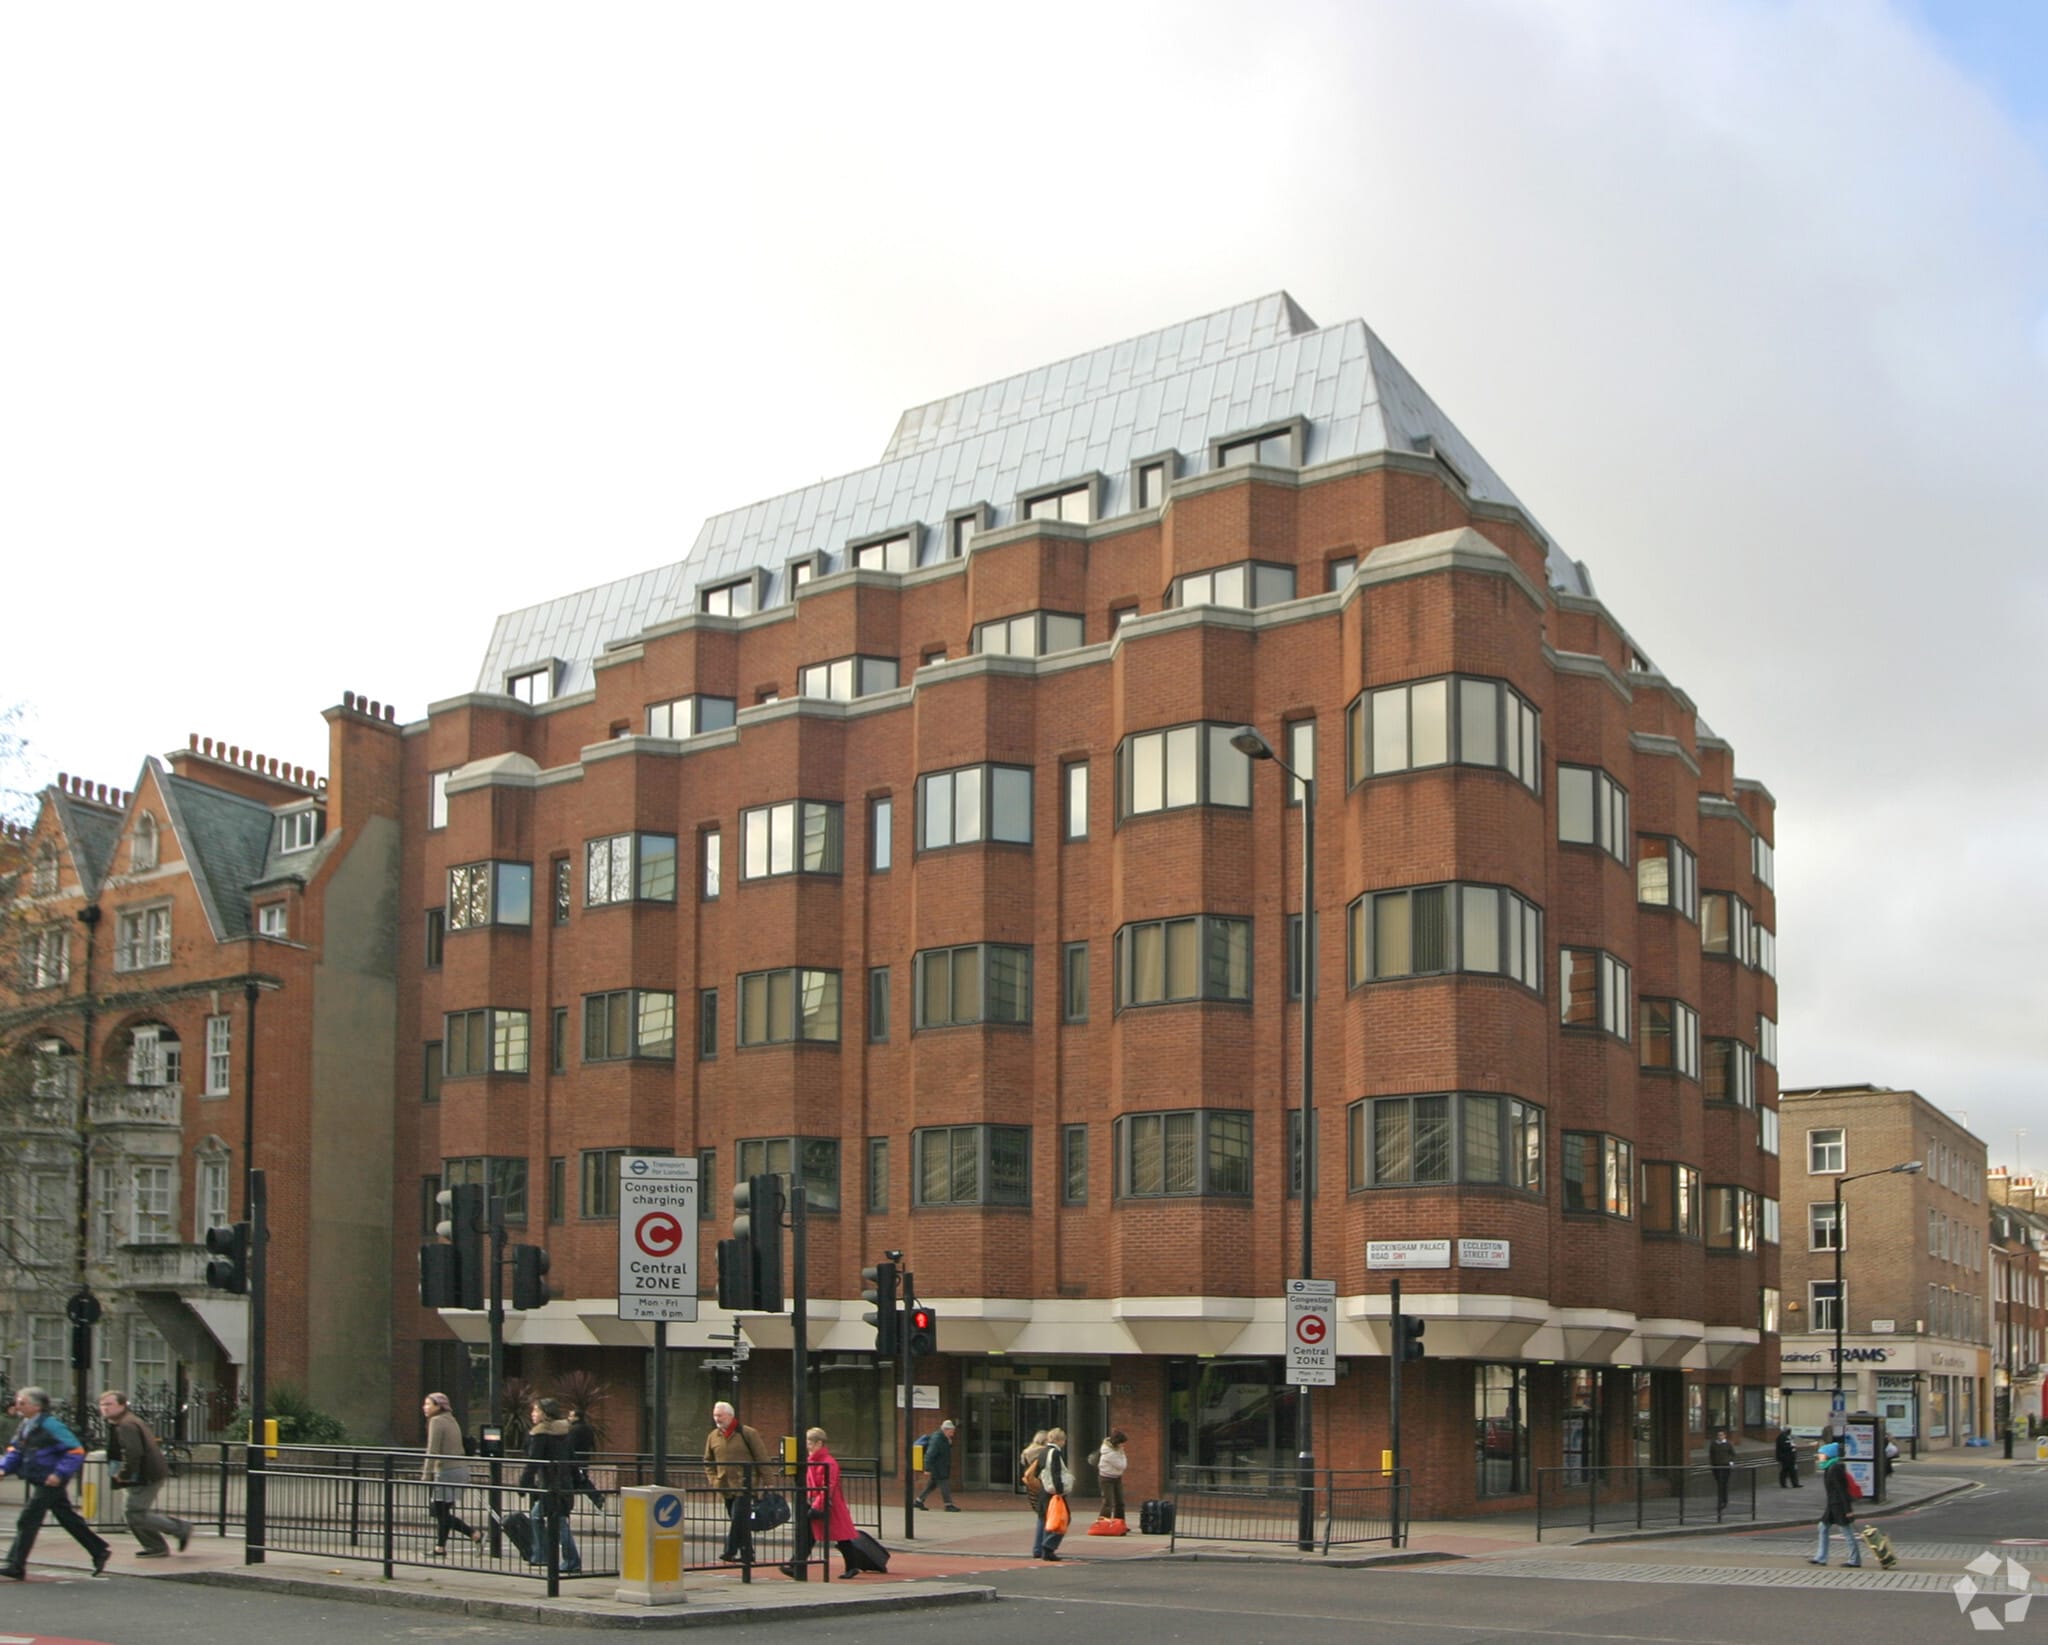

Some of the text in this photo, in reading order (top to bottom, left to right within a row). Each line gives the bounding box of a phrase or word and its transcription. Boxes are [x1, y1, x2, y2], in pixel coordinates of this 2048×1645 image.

[624, 1182, 693, 1193] Congestion
[632, 1195, 685, 1207] charging
[1370, 1242, 1446, 1251] BUCKINGHAM PALACE
[1370, 1252, 1390, 1260] ROAD
[1463, 1250, 1489, 1258] STREET
[630, 1261, 687, 1275] Central
[635, 1276, 681, 1290] ZONE
[639, 1298, 659, 1306] Mon
[666, 1299, 678, 1307] Fri
[1290, 1295, 1333, 1304] Congestion
[1295, 1304, 1328, 1312] charging
[1293, 1346, 1329, 1355] Central
[1780, 1348, 1886, 1362] usiness TRAMS
[1296, 1356, 1326, 1365] ZONE
